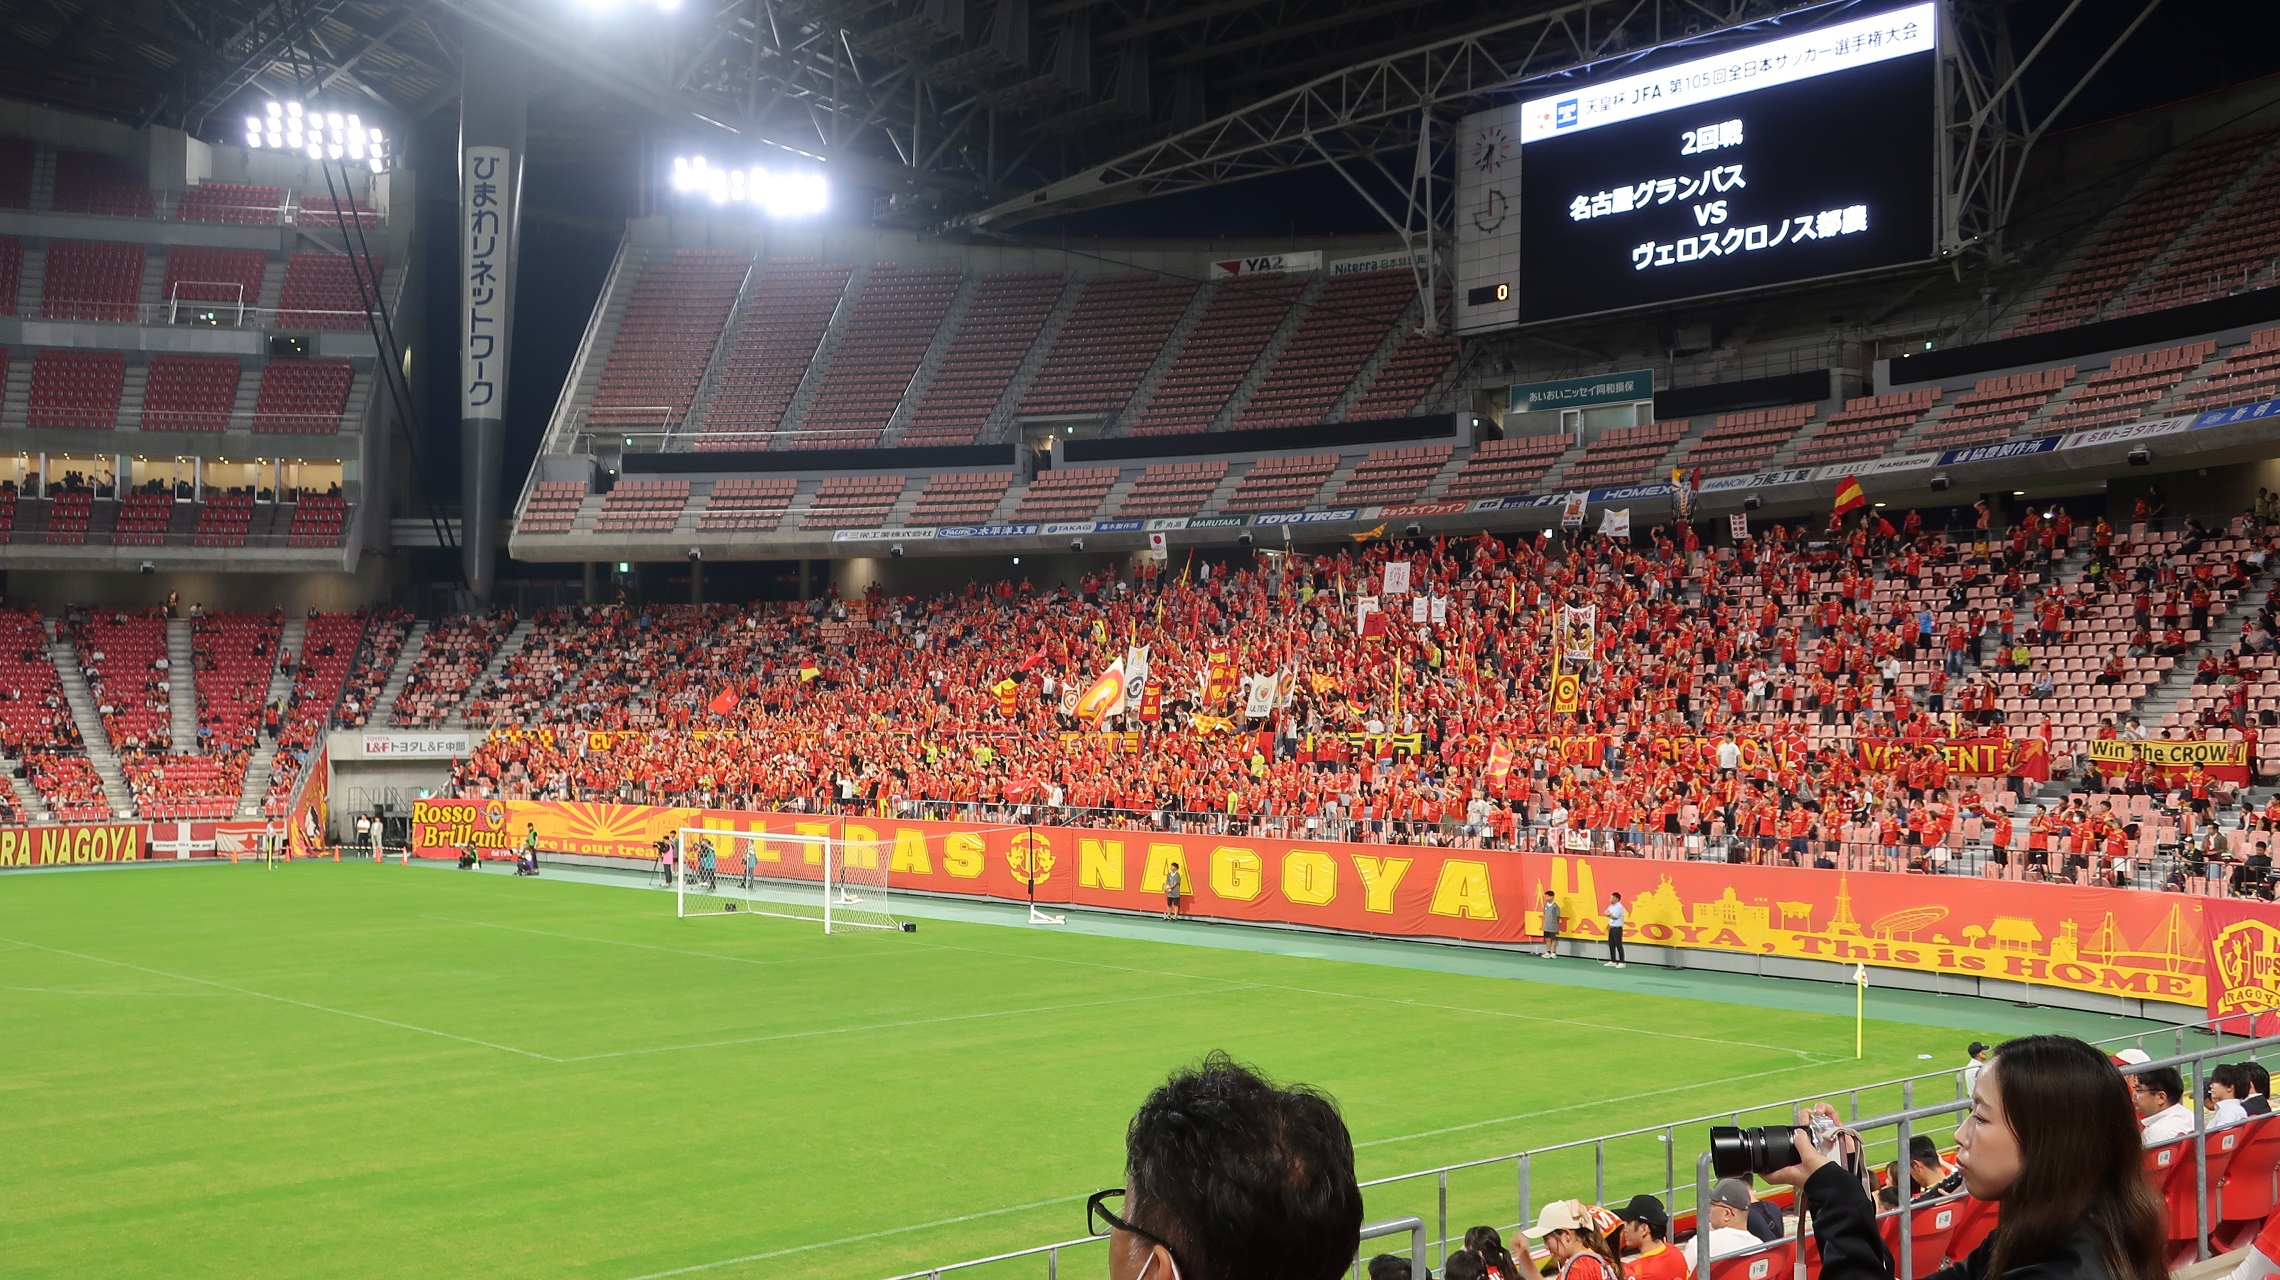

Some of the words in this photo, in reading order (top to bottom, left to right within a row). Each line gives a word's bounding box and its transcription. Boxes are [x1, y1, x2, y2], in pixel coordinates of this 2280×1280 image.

[1586, 91, 1626, 115] 天皇杯
[1631, 84, 1662, 105] JFA
[1681, 119, 1744, 156] 2回戦
[1569, 164, 1747, 222] 名古屋グランパス
[1694, 200, 1728, 227] VS
[1632, 204, 1868, 271] ヴェロスクロノス都農
[1334, 260, 1378, 275] Niterra
[469, 156, 500, 407] ひまわりネットワーク
[1497, 284, 1509, 301] 0
[1529, 380, 1634, 402] あいおいニッセイ同和損保
[1748, 469, 1811, 488] 万能工業
[1257, 512, 1302, 525] TOYO
[1304, 509, 1355, 522] TIRES
[1380, 503, 1467, 517] キョウエイファイン
[978, 525, 1037, 536] 太平洋工業
[1190, 518, 1241, 528] MARUTAKA
[366, 742, 390, 753] L&F
[391, 741, 466, 752] トヨタL&F中部
[2092, 740, 2125, 758] Win
[412, 801, 478, 824] Rosso
[40, 826, 138, 865] NAGOYA
[510, 836, 559, 850] Hre
[561, 839, 577, 852] is
[588, 842, 613, 855] our
[617, 843, 660, 858] trea
[702, 815, 986, 879] ULTRAS
[1078, 837, 1499, 921] NAGOYA
[1797, 935, 1921, 964] This
[1937, 948, 1987, 971] is
[2003, 955, 2194, 999] HOME
